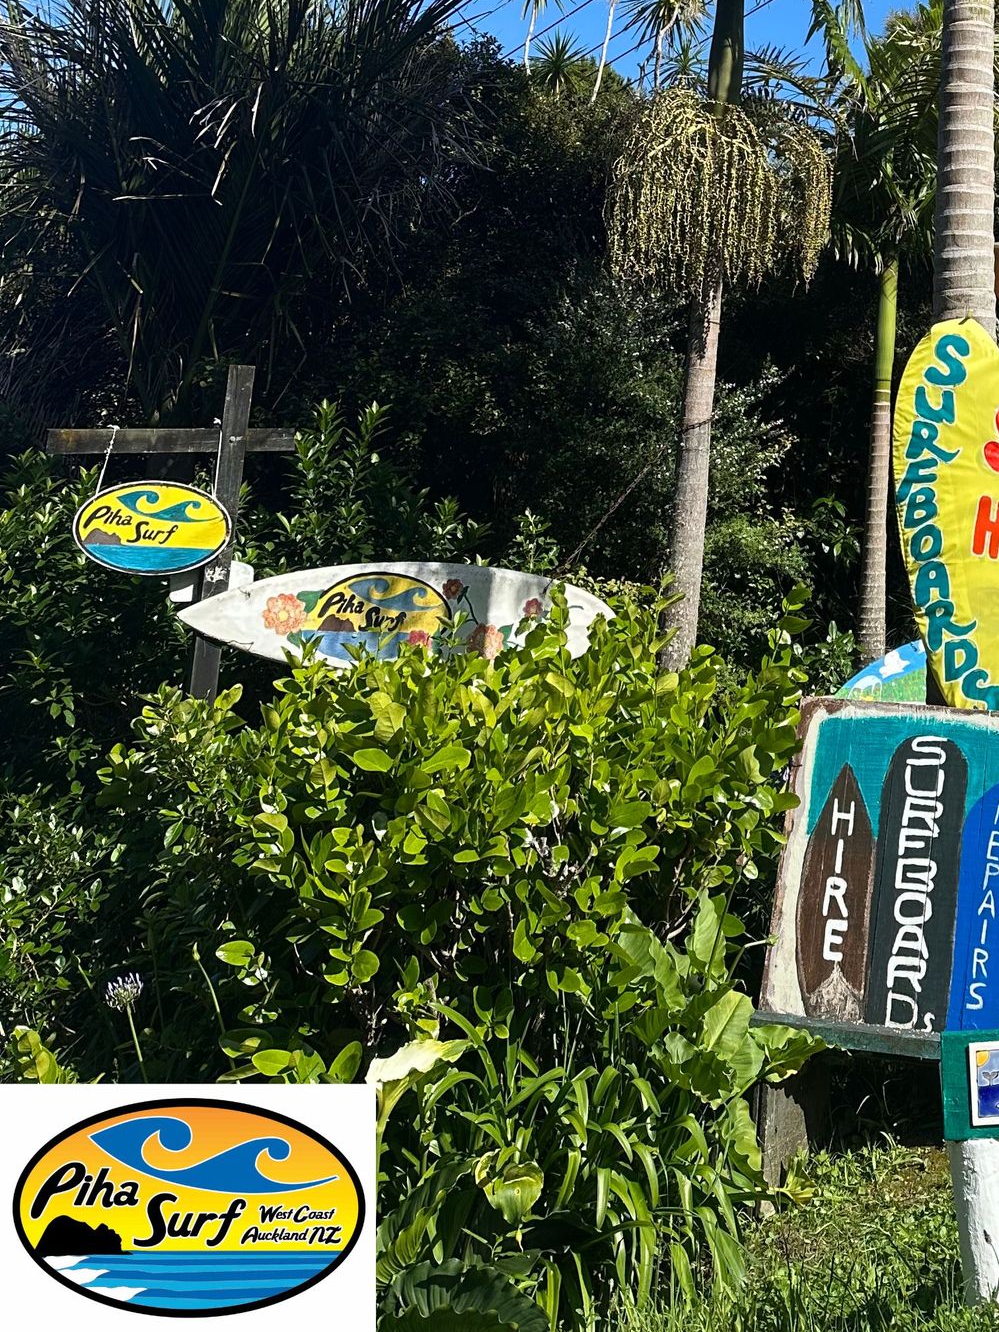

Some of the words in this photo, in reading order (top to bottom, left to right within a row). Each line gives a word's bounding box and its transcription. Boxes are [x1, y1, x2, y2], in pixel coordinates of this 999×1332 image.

[83, 505, 132, 529] Piha
[126, 521, 178, 544] Surf
[317, 592, 364, 618] Piha
[822, 798, 855, 962] HIRE
